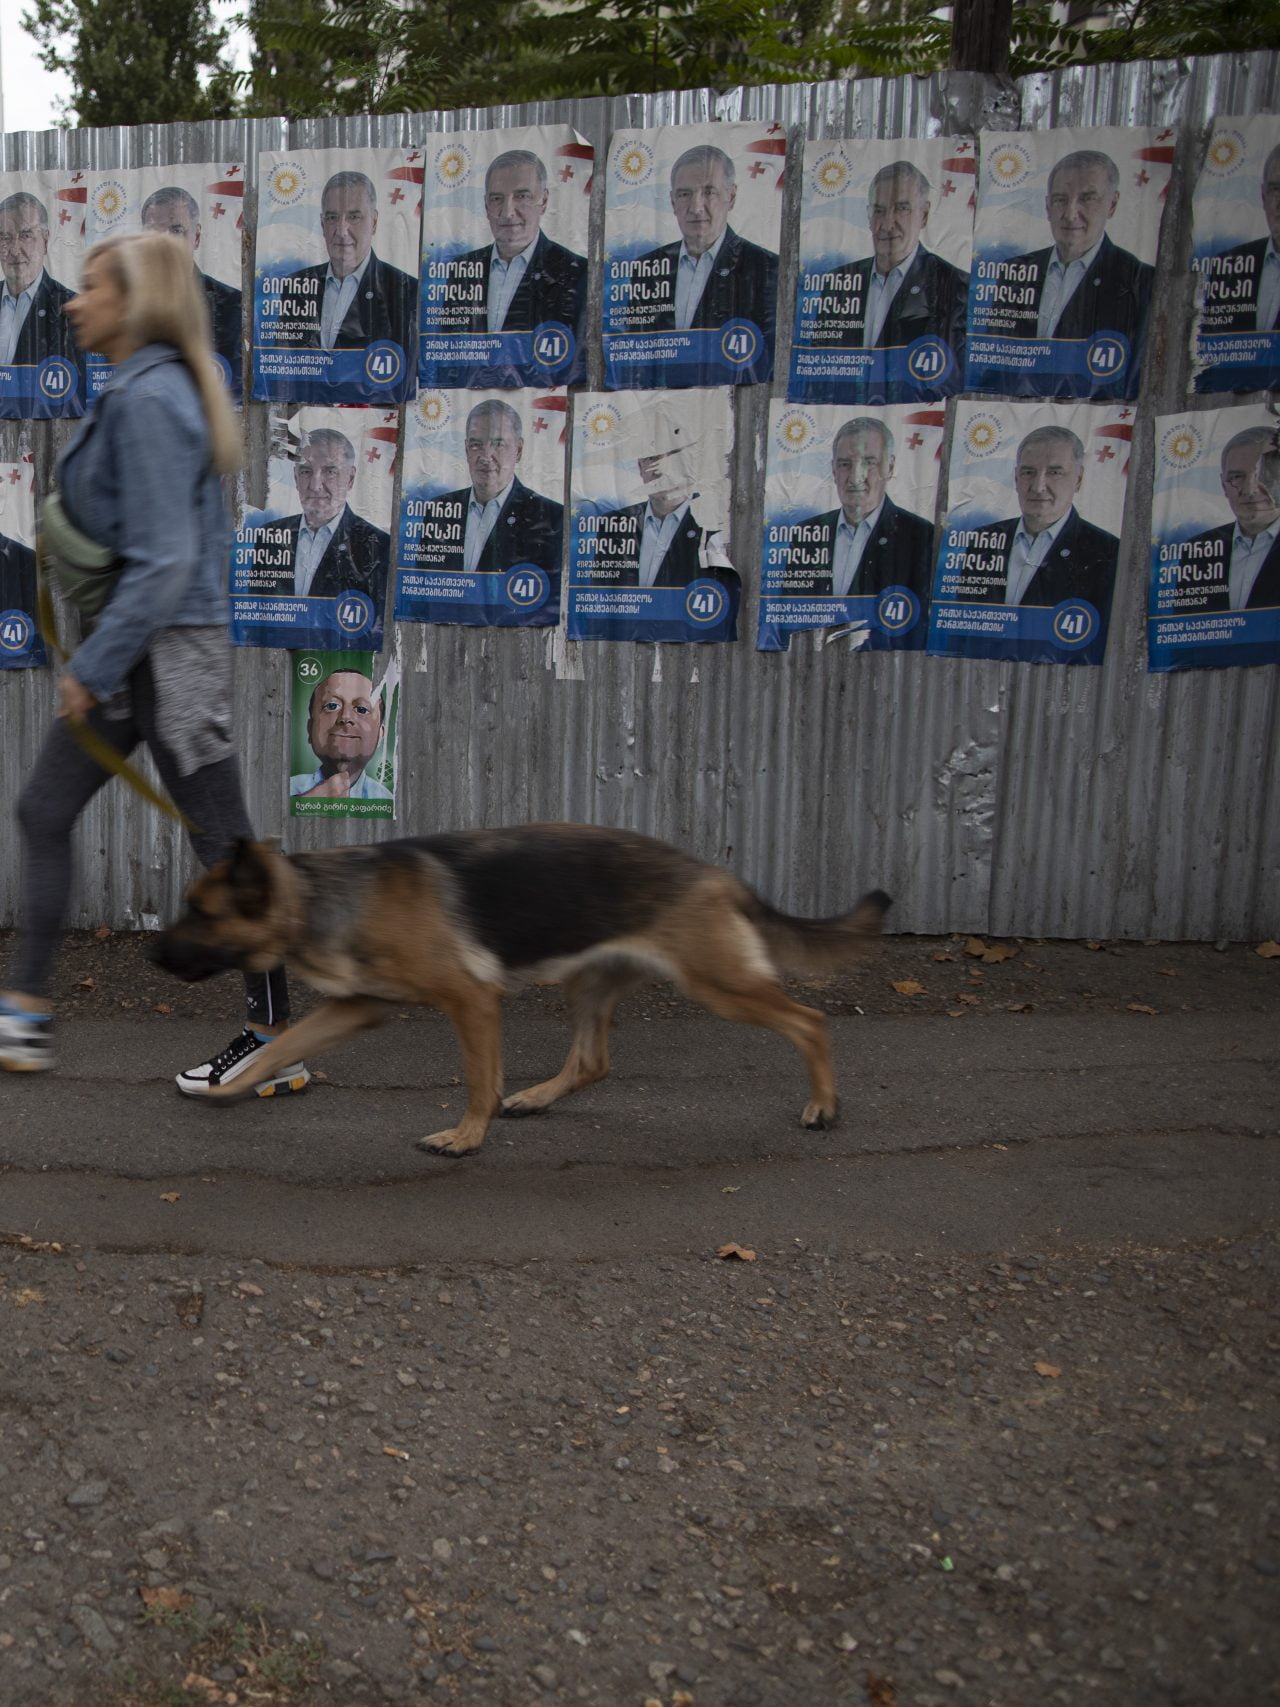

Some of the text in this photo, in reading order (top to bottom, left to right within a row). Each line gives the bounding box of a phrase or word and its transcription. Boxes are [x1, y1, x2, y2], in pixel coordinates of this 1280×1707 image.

[428, 261, 483, 279] გიორგი
[611, 258, 670, 279] გიორგი
[978, 261, 1037, 282] გიორგი
[262, 278, 318, 295] გიორგი
[428, 283, 482, 301] ვოლსკი
[611, 281, 670, 301] ვოლსკი
[804, 274, 862, 292] გიორგი
[976, 284, 1035, 304] ვოლსკი
[262, 299, 317, 317] ვოლსკი
[803, 297, 861, 315] ვოლსკი
[539, 337, 561, 356] 41
[728, 334, 747, 354] 41
[372, 356, 392, 374] 41
[916, 352, 939, 372] 41
[1092, 347, 1115, 367] 41
[407, 500, 461, 518] გიორგი
[406, 522, 460, 540] ვოლსკი
[578, 516, 637, 534] გიორგი
[236, 528, 292, 545] გიორგი
[769, 525, 829, 544] გიორგი
[949, 529, 1006, 550] გიორგი
[578, 538, 635, 557] ვოლსკი
[768, 548, 828, 565] ვოლსკი
[1160, 539, 1223, 562] გიორგი
[236, 549, 291, 566] ვოლსკი
[946, 552, 1004, 572] ვოლსკი
[1160, 561, 1223, 584] ვოლსკი
[514, 579, 535, 597] 41
[693, 595, 715, 613] 41
[885, 602, 905, 620] 41
[343, 607, 362, 624] 41
[1061, 615, 1083, 634] 41
[4, 625, 21, 641] 41
[300, 664, 317, 676] 36
[296, 802, 392, 813] ზურაბ გირჩი ჯაფარიძე
